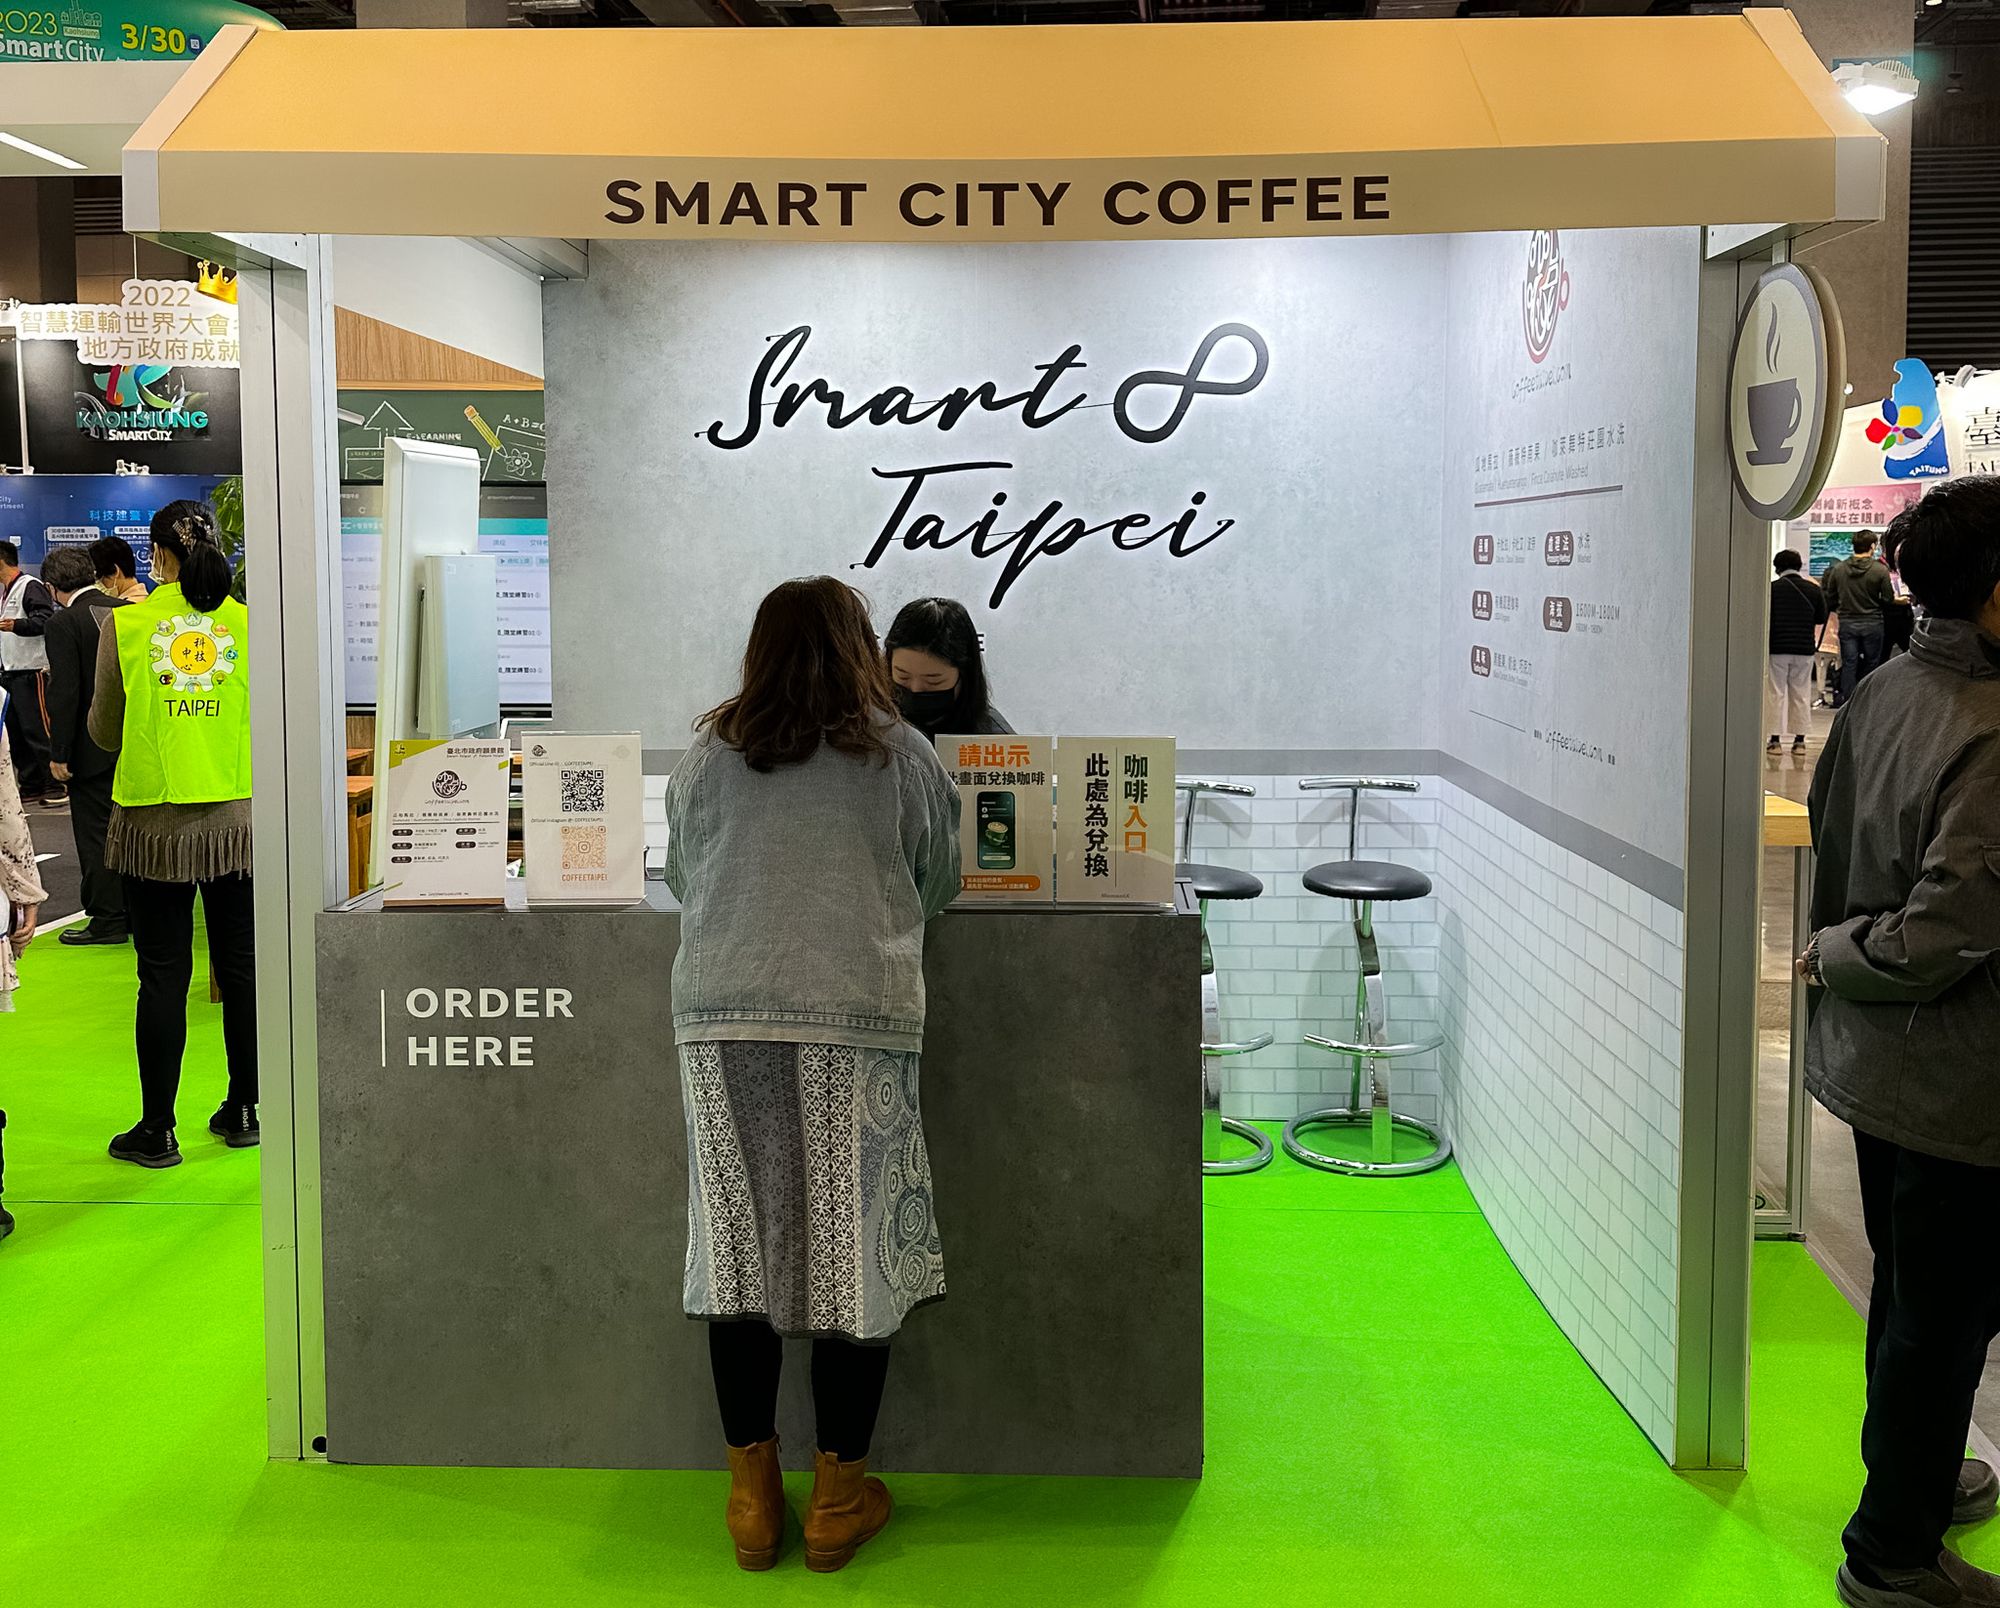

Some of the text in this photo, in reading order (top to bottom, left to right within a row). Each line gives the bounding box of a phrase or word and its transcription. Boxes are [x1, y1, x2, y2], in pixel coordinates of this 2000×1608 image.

[121, 23, 186, 54] 3/30
[604, 175, 1391, 227] SMART CITY COFFEE
[129, 285, 191, 307] 2022
[20, 310, 238, 337] 智慧運輸世界大會
[84, 337, 239, 361] 地方政府成就
[704, 325, 1088, 449] Smart
[76, 410, 208, 429] KAOHSIUNG
[1909, 464, 1948, 477] TAITUNG
[1965, 459, 2000, 474] TAI
[858, 461, 1235, 609] Taipei
[164, 700, 220, 717] TAIPEI
[959, 743, 1030, 767] 請出示
[1084, 752, 1109, 877] 此處為兌換
[1124, 754, 1148, 853] 咖啡入口
[561, 873, 608, 881] COFFEETAIPEI
[405, 987, 574, 1018] ORDER
[408, 1036, 534, 1066] HERE
